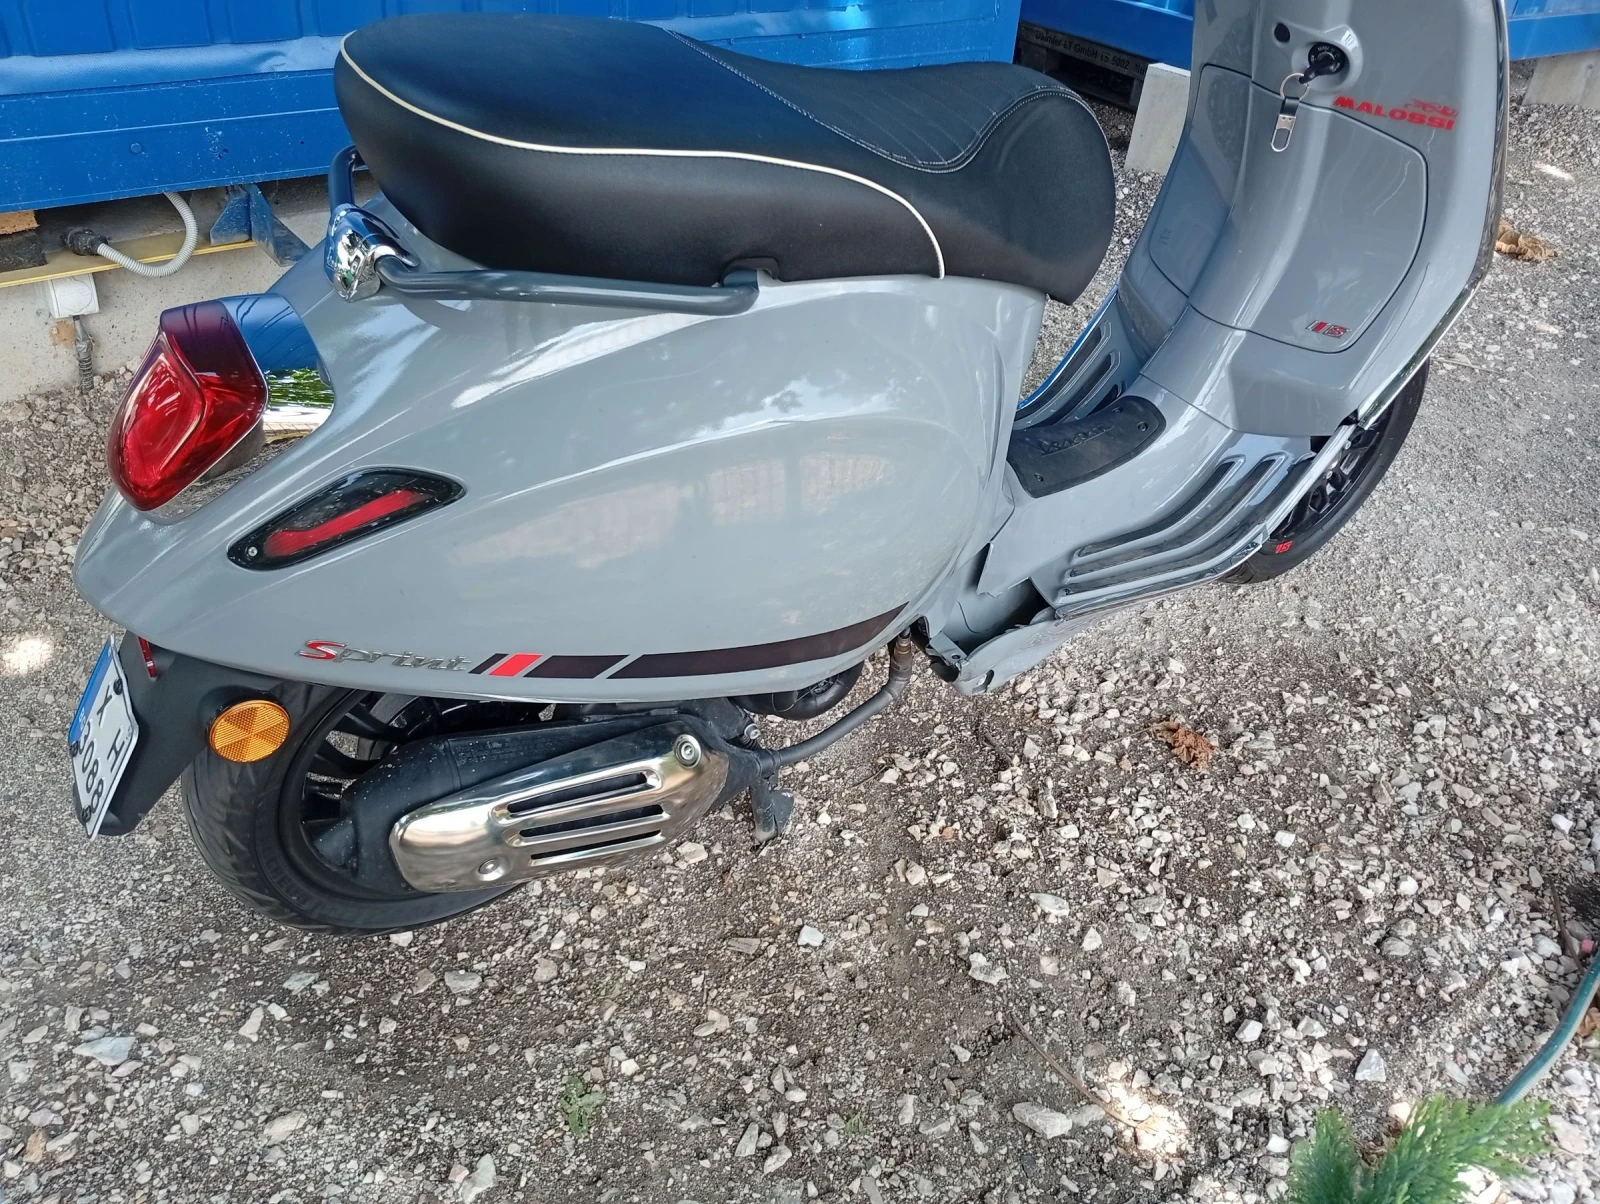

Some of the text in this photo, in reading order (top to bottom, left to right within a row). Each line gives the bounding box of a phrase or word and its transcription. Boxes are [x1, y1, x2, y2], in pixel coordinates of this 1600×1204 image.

[1064, 40, 1074, 51] LT
[1074, 43, 1098, 59] GmbH
[1111, 55, 1130, 70] 5002
[1333, 96, 1456, 130] MALOSSI
[294, 639, 473, 672] Sprint
[96, 684, 126, 774] X H
[78, 720, 106, 814] 3088
